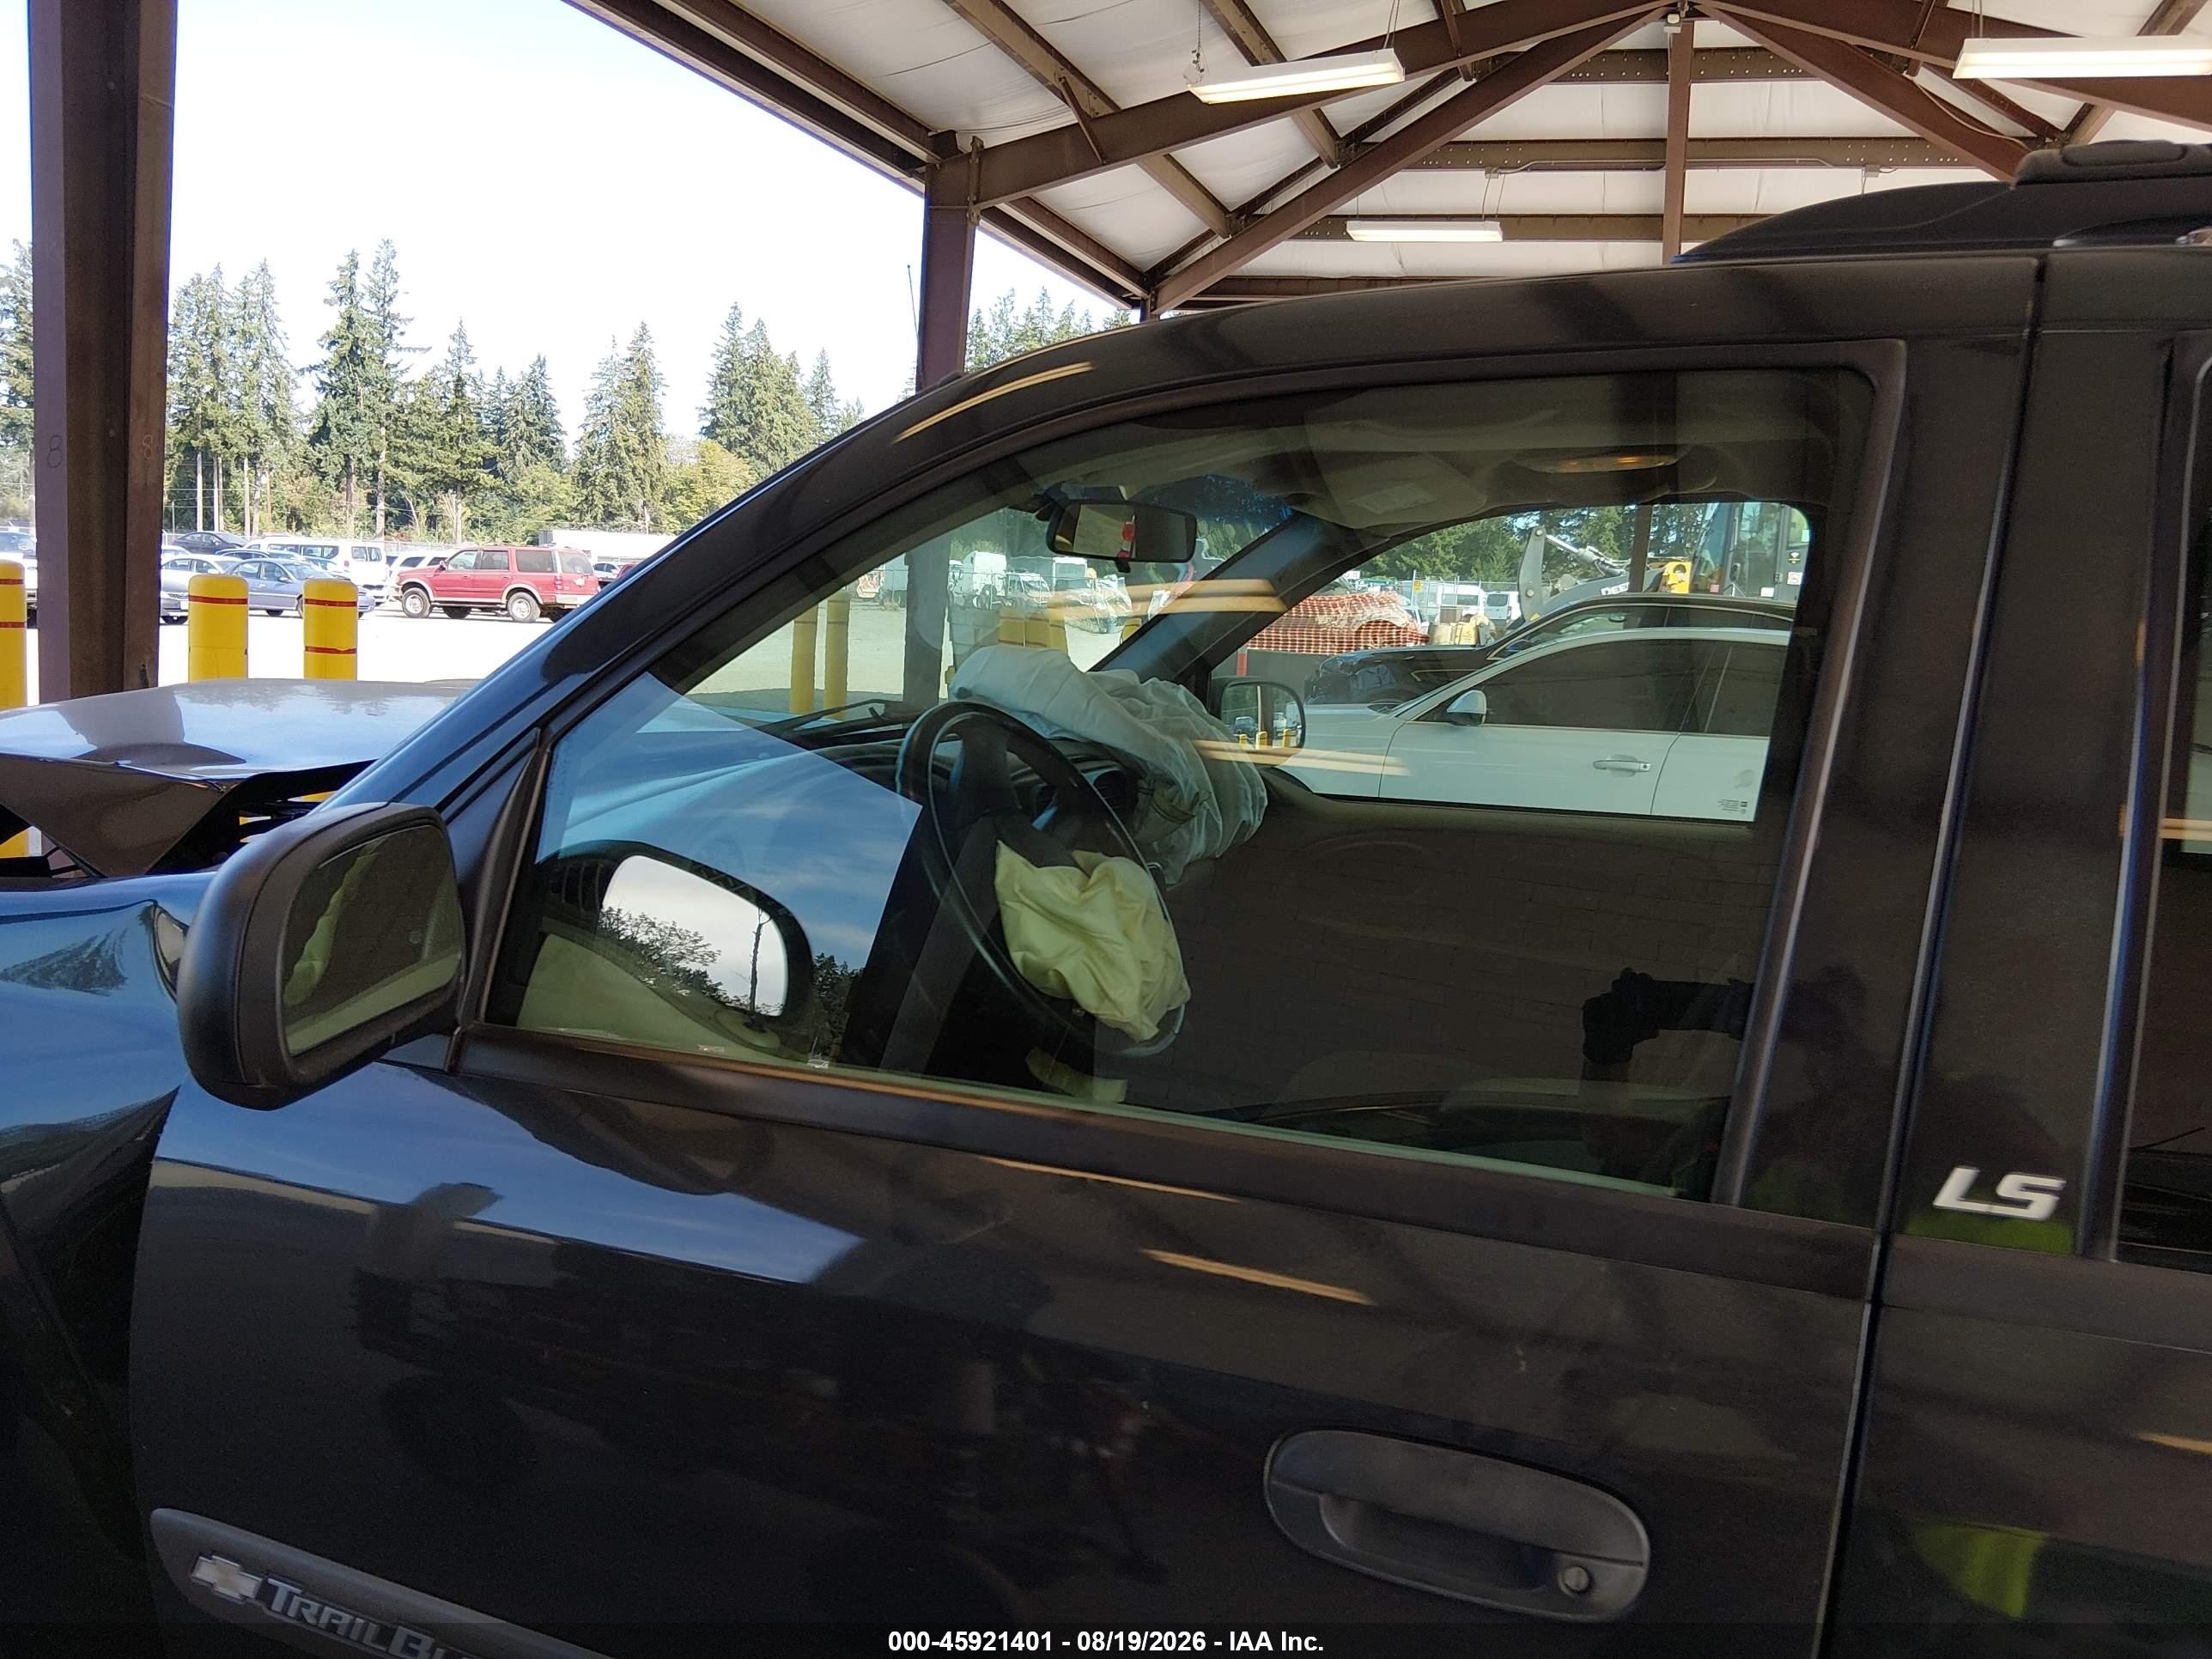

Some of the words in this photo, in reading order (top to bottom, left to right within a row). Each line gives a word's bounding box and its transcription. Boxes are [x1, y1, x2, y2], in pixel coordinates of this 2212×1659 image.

[47, 434, 63, 468] 8
[1933, 1166, 2067, 1219] LS
[267, 1577, 471, 1659] TRAILB
